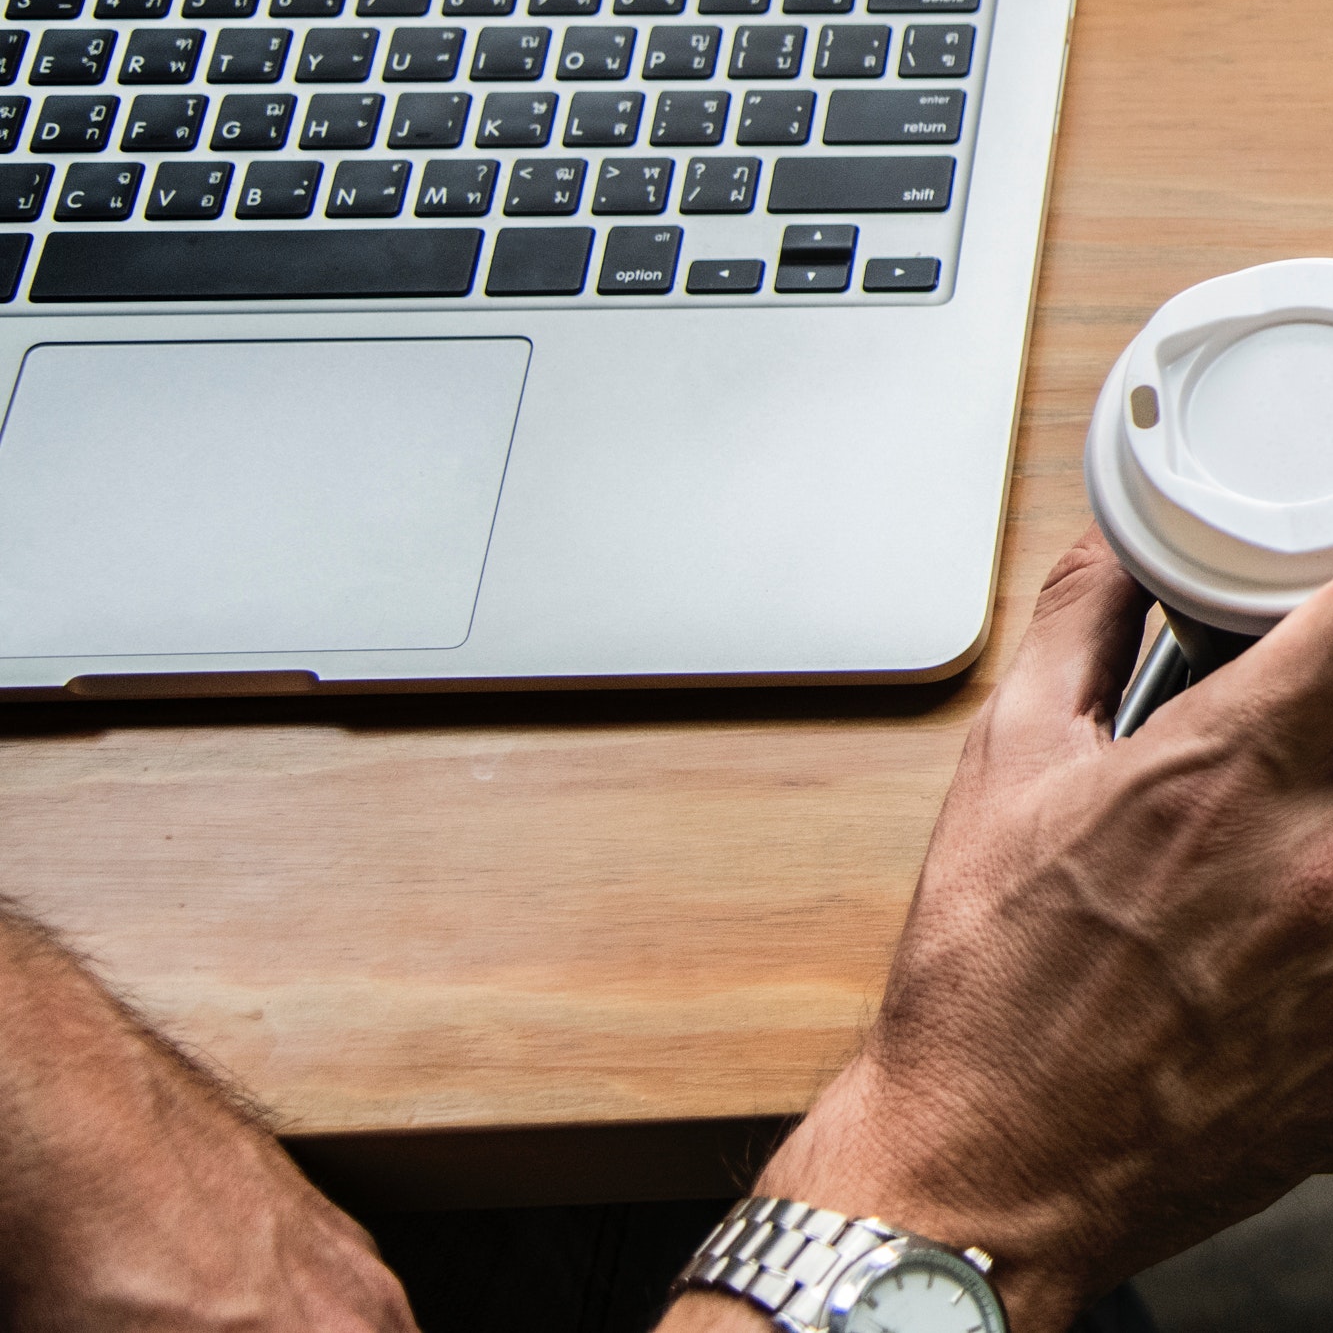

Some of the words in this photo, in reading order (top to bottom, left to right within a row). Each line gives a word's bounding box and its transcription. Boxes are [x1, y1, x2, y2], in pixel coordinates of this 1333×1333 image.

[40, 56, 54, 73] E
[129, 56, 144, 72] R
[221, 55, 233, 72] T
[309, 54, 323, 71] Y
[392, 53, 411, 70] U
[479, 52, 486, 69] I
[565, 52, 584, 69] O
[650, 51, 665, 68] P
[920, 96, 950, 104] enter
[42, 123, 60, 139] D
[132, 122, 146, 138] F
[222, 121, 240, 138] G
[309, 121, 329, 137] H
[397, 120, 410, 137] J
[485, 119, 502, 136] K
[572, 118, 582, 135] L
[904, 122, 946, 132] return
[67, 191, 84, 208] C
[160, 190, 176, 206] V
[247, 188, 261, 205] B
[337, 188, 356, 205] N
[424, 187, 447, 204] M
[903, 189, 934, 200] shift
[655, 232, 670, 241] alt
[616, 270, 662, 283] option
